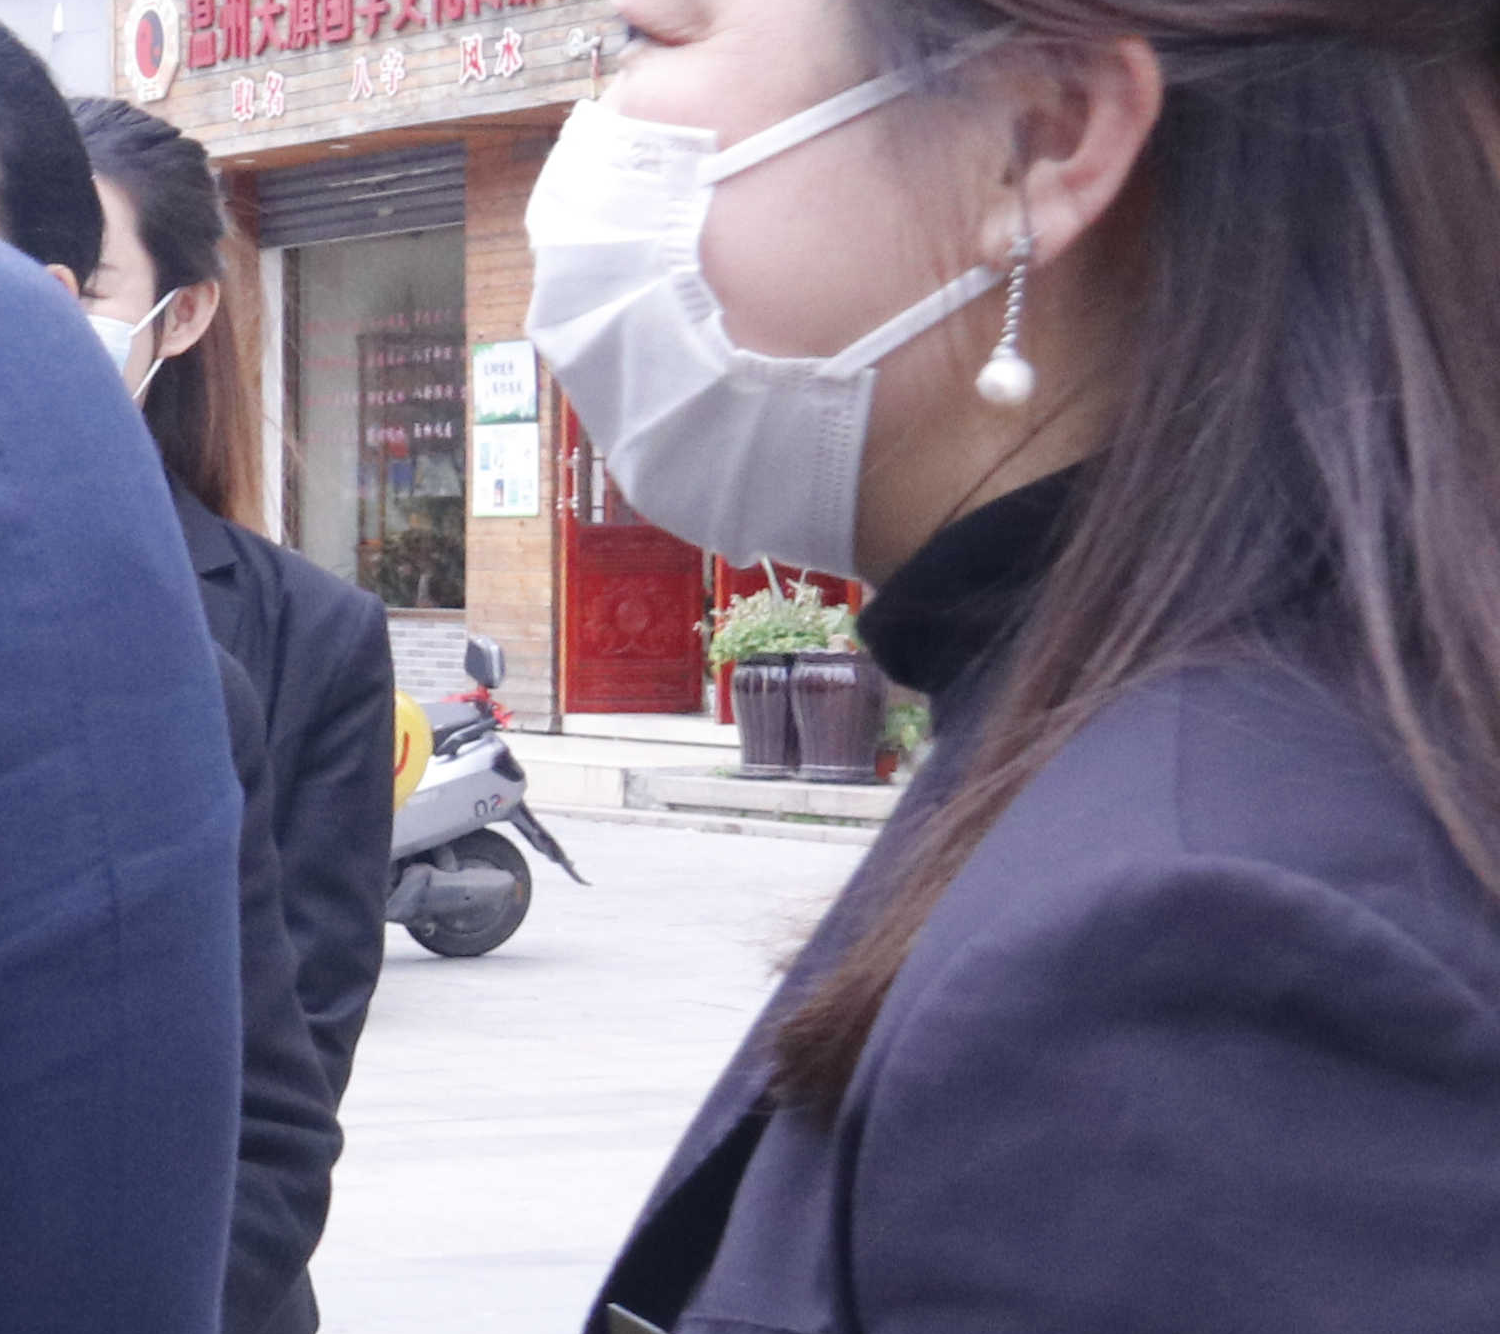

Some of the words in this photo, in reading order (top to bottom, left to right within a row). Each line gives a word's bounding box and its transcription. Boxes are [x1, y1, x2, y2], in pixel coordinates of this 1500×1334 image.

[231, 70, 285, 122] 取名
[348, 47, 406, 101] 八字
[460, 26, 525, 84] 风水
